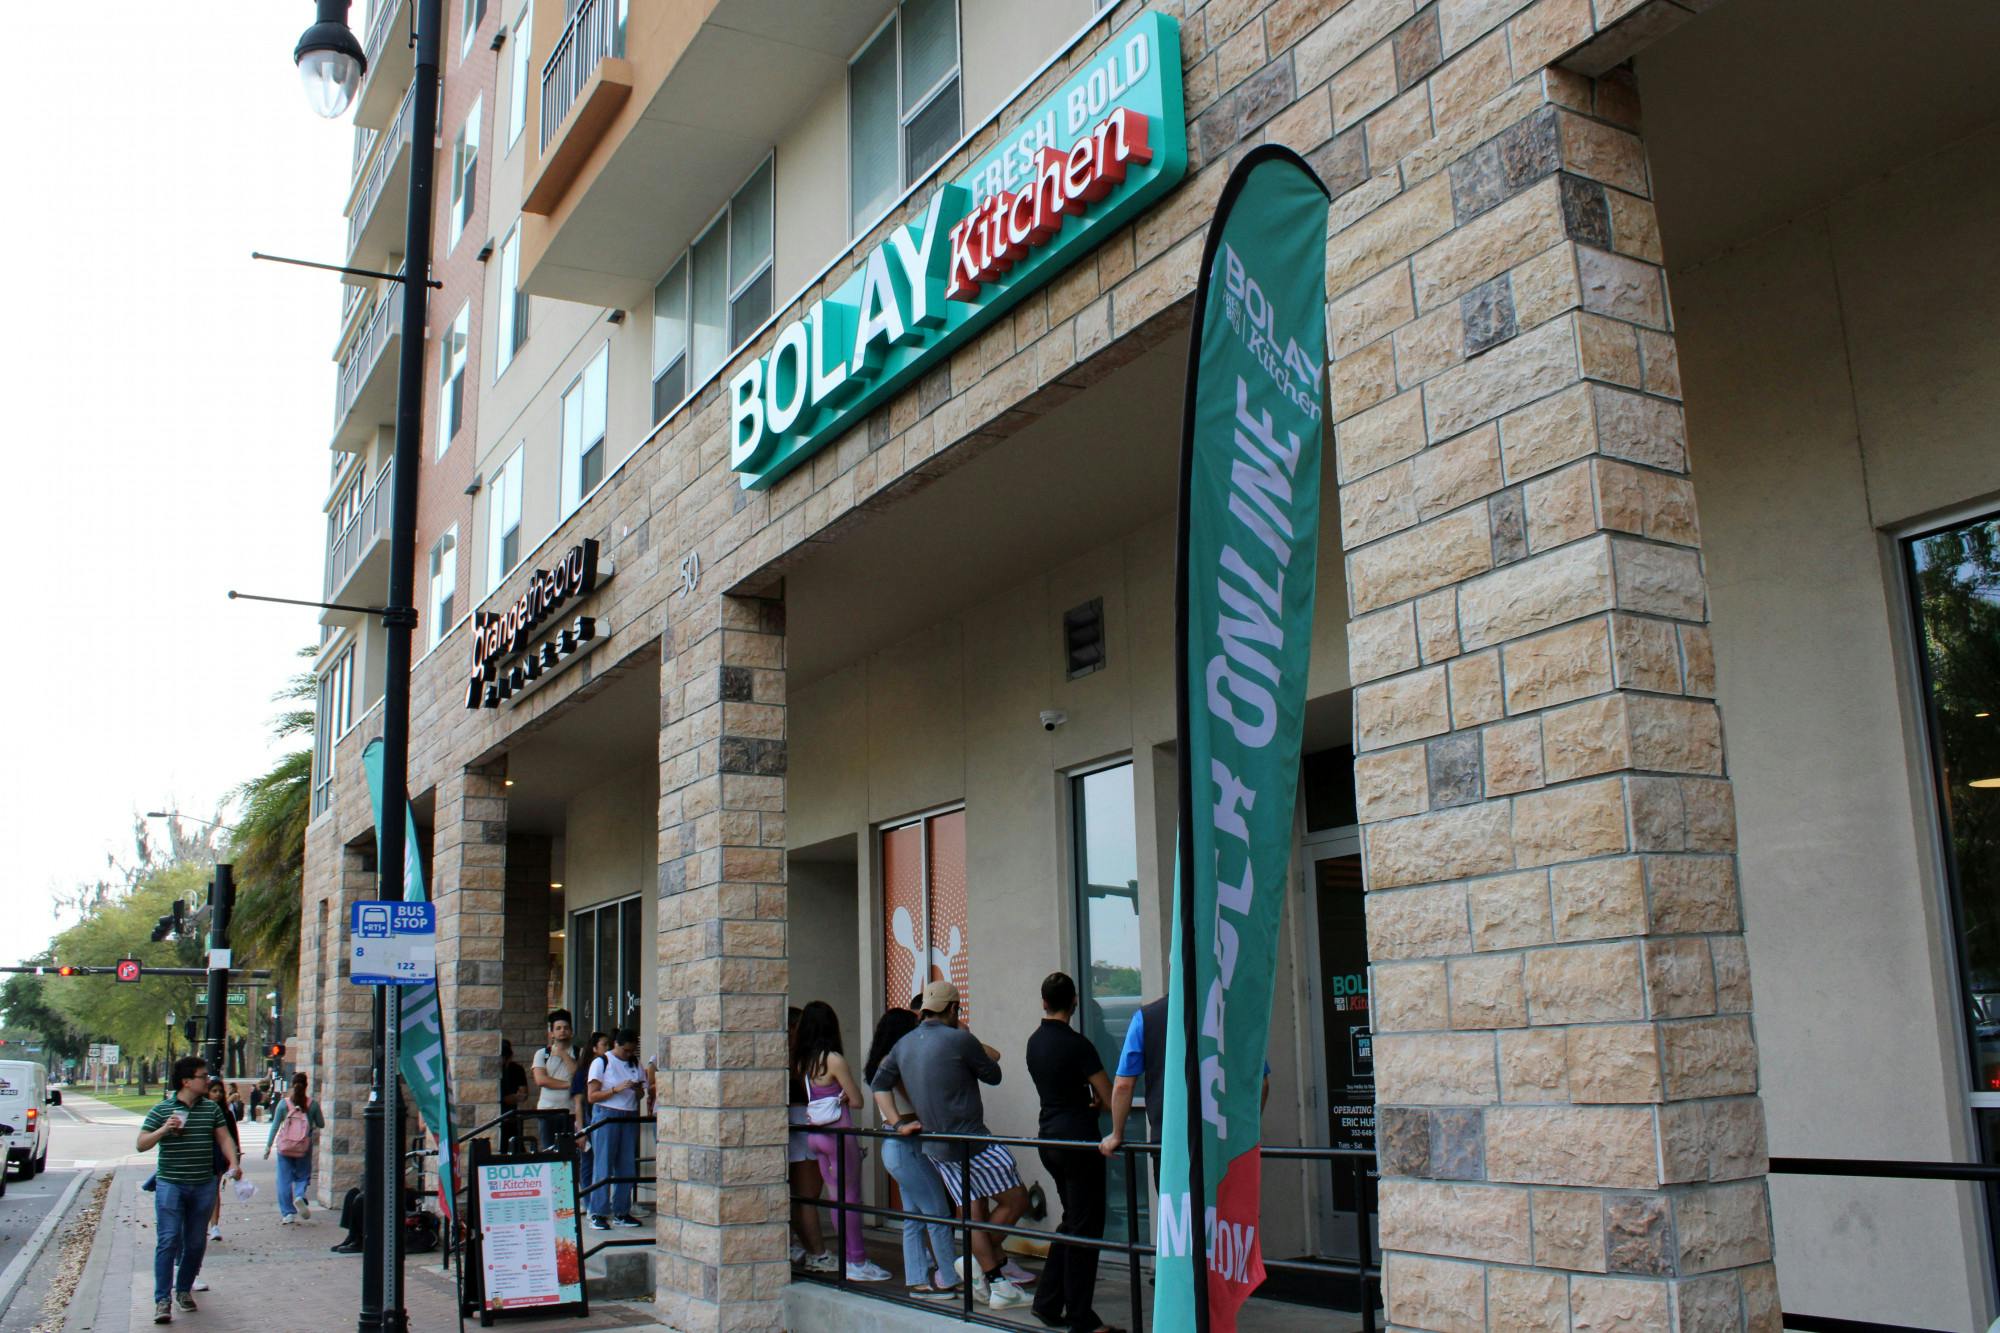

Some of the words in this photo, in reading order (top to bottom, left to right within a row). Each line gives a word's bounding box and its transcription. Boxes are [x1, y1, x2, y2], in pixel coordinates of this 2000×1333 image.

[971, 108, 1057, 206] FRESH
[1067, 32, 1149, 136] BOLD
[946, 106, 1135, 301] Kitchen
[1225, 242, 1324, 395] BOLAY
[729, 183, 946, 472] BOLAY
[1247, 325, 1323, 421] Kitchen
[1205, 374, 1301, 749] ONLINE
[679, 550, 700, 599] 50
[398, 905, 425, 917] BUS
[393, 917, 428, 929] STOP
[355, 946, 365, 957] 8
[397, 962, 416, 970] 122
[1332, 974, 1369, 996] BOL
[1359, 1047, 1371, 1056] LATE
[1333, 1105, 1372, 1114] OPERATING
[1341, 1118, 1359, 1127] ERIC
[1360, 1117, 1376, 1127] HUF
[486, 1165, 542, 1180] BOLAY
[502, 1179, 542, 1190] Kitchen
